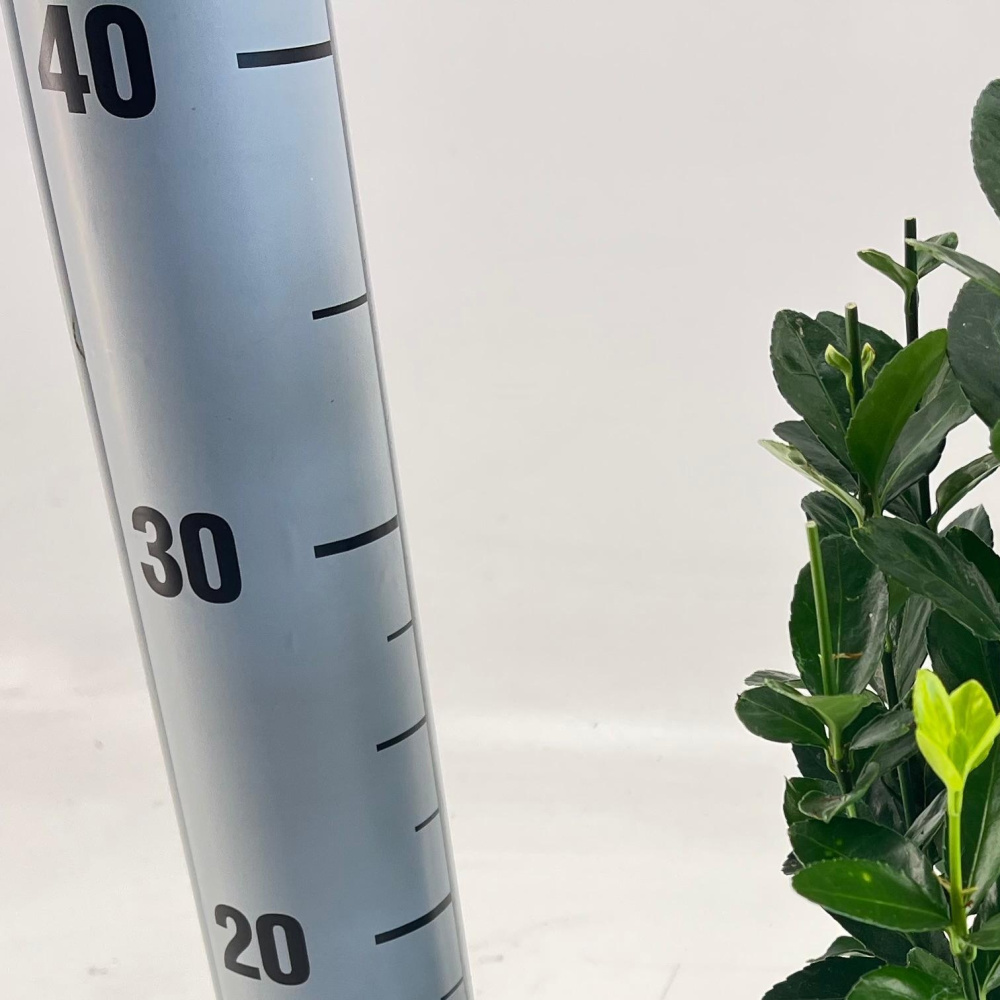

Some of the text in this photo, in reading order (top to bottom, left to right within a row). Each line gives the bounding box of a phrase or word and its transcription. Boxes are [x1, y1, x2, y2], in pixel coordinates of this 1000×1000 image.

[38, 4, 157, 119] 40
[131, 505, 242, 604] 30
[214, 904, 310, 986] 20
